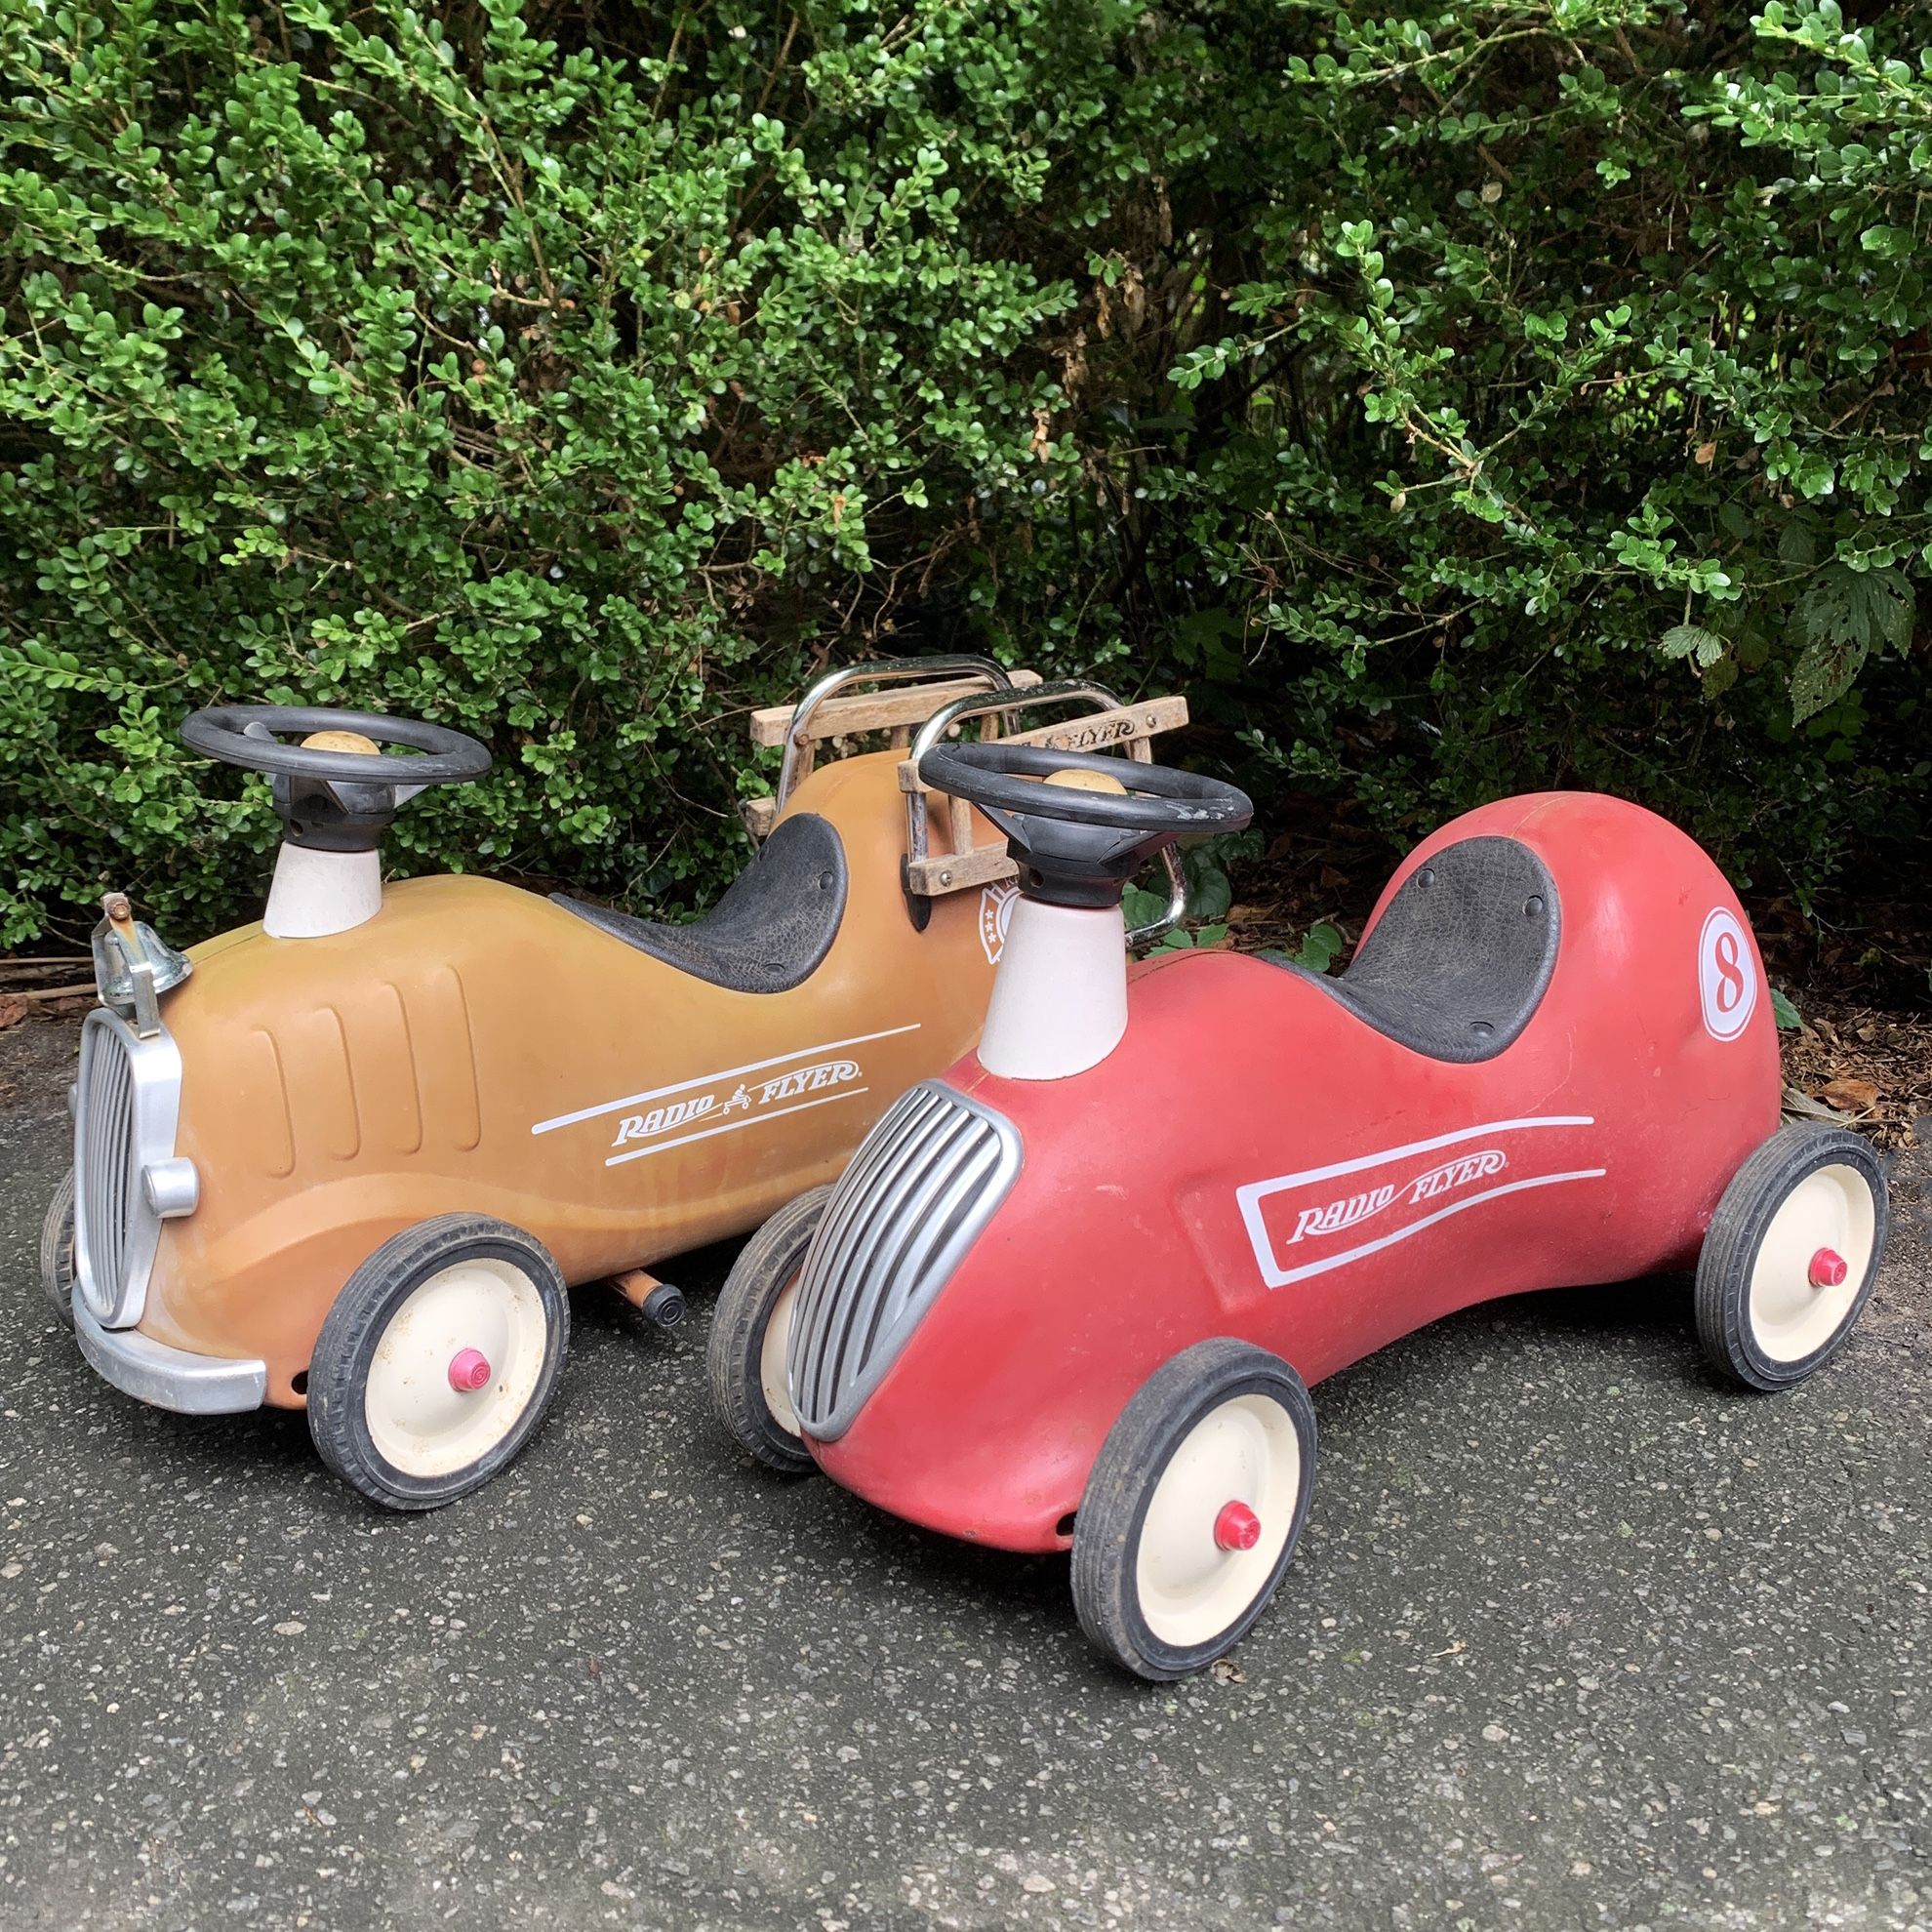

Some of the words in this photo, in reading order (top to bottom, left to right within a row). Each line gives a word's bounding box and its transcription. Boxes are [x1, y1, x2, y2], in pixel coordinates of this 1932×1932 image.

[1714, 931, 1745, 1014] 8
[611, 1094, 716, 1147] RADIO
[757, 1061, 860, 1105] FLYER
[1286, 1184, 1395, 1245] RADIO
[1408, 1149, 1507, 1205] FLYER
